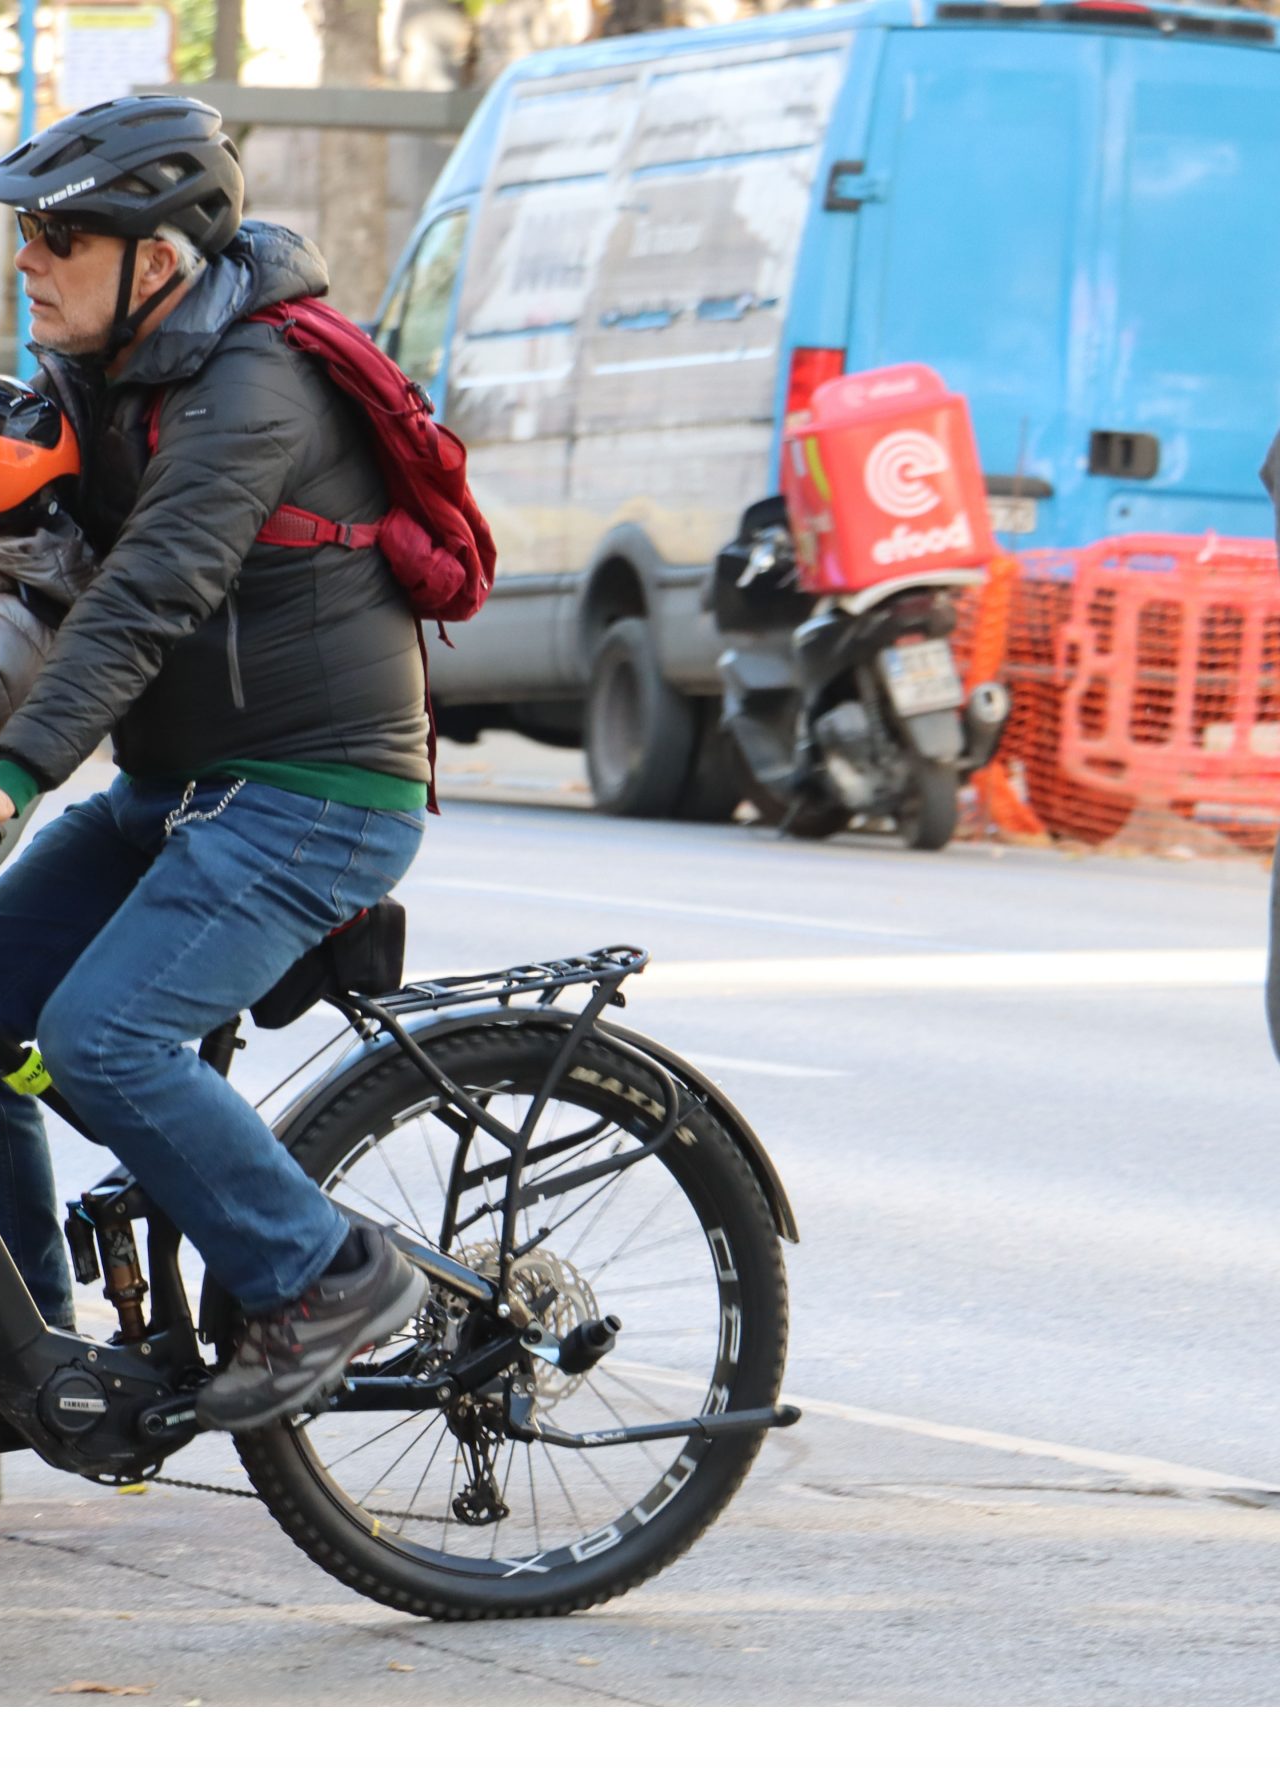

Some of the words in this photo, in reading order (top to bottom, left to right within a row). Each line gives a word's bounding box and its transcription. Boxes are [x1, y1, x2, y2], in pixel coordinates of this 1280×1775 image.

[872, 512, 971, 565] efood
[568, 1065, 699, 1147] MAXXS
[63, 1400, 90, 1409] YAMAHA
